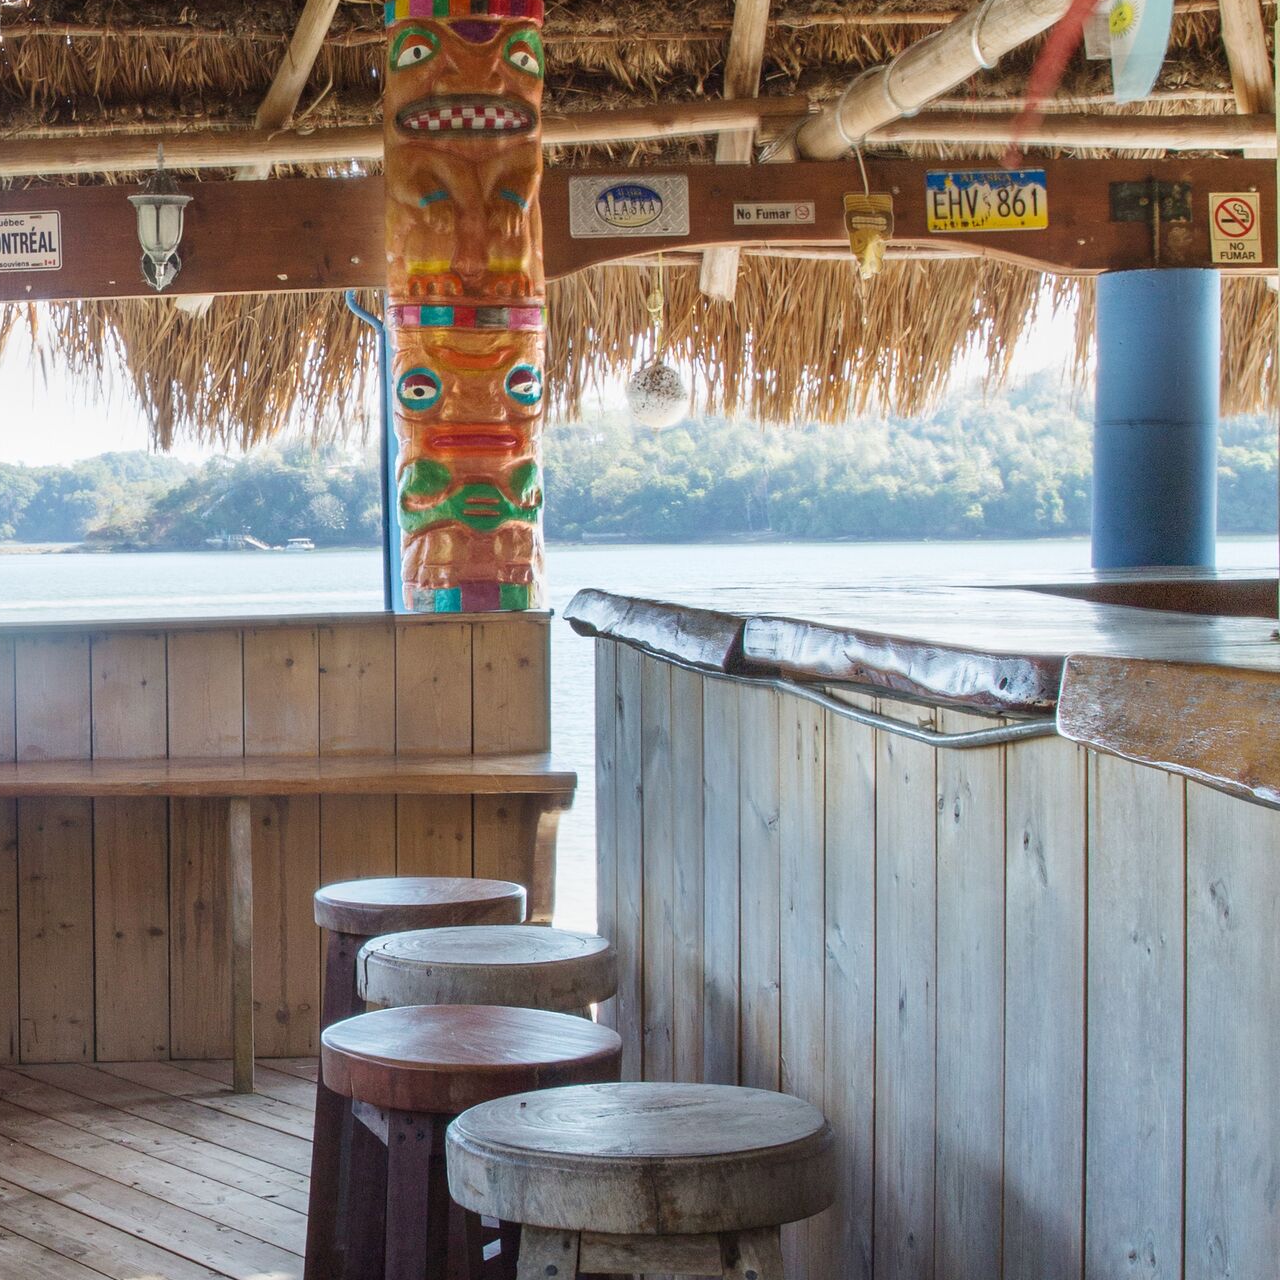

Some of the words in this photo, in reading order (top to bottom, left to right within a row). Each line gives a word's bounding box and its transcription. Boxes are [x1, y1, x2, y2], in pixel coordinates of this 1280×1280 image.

[605, 199, 656, 216] ALASKA
[933, 189, 978, 220] EHV
[997, 185, 1038, 218] 861
[737, 209, 751, 220] No
[756, 209, 791, 220] Fumar
[1230, 242, 1245, 251] NO
[1220, 251, 1256, 260] FUMAR
